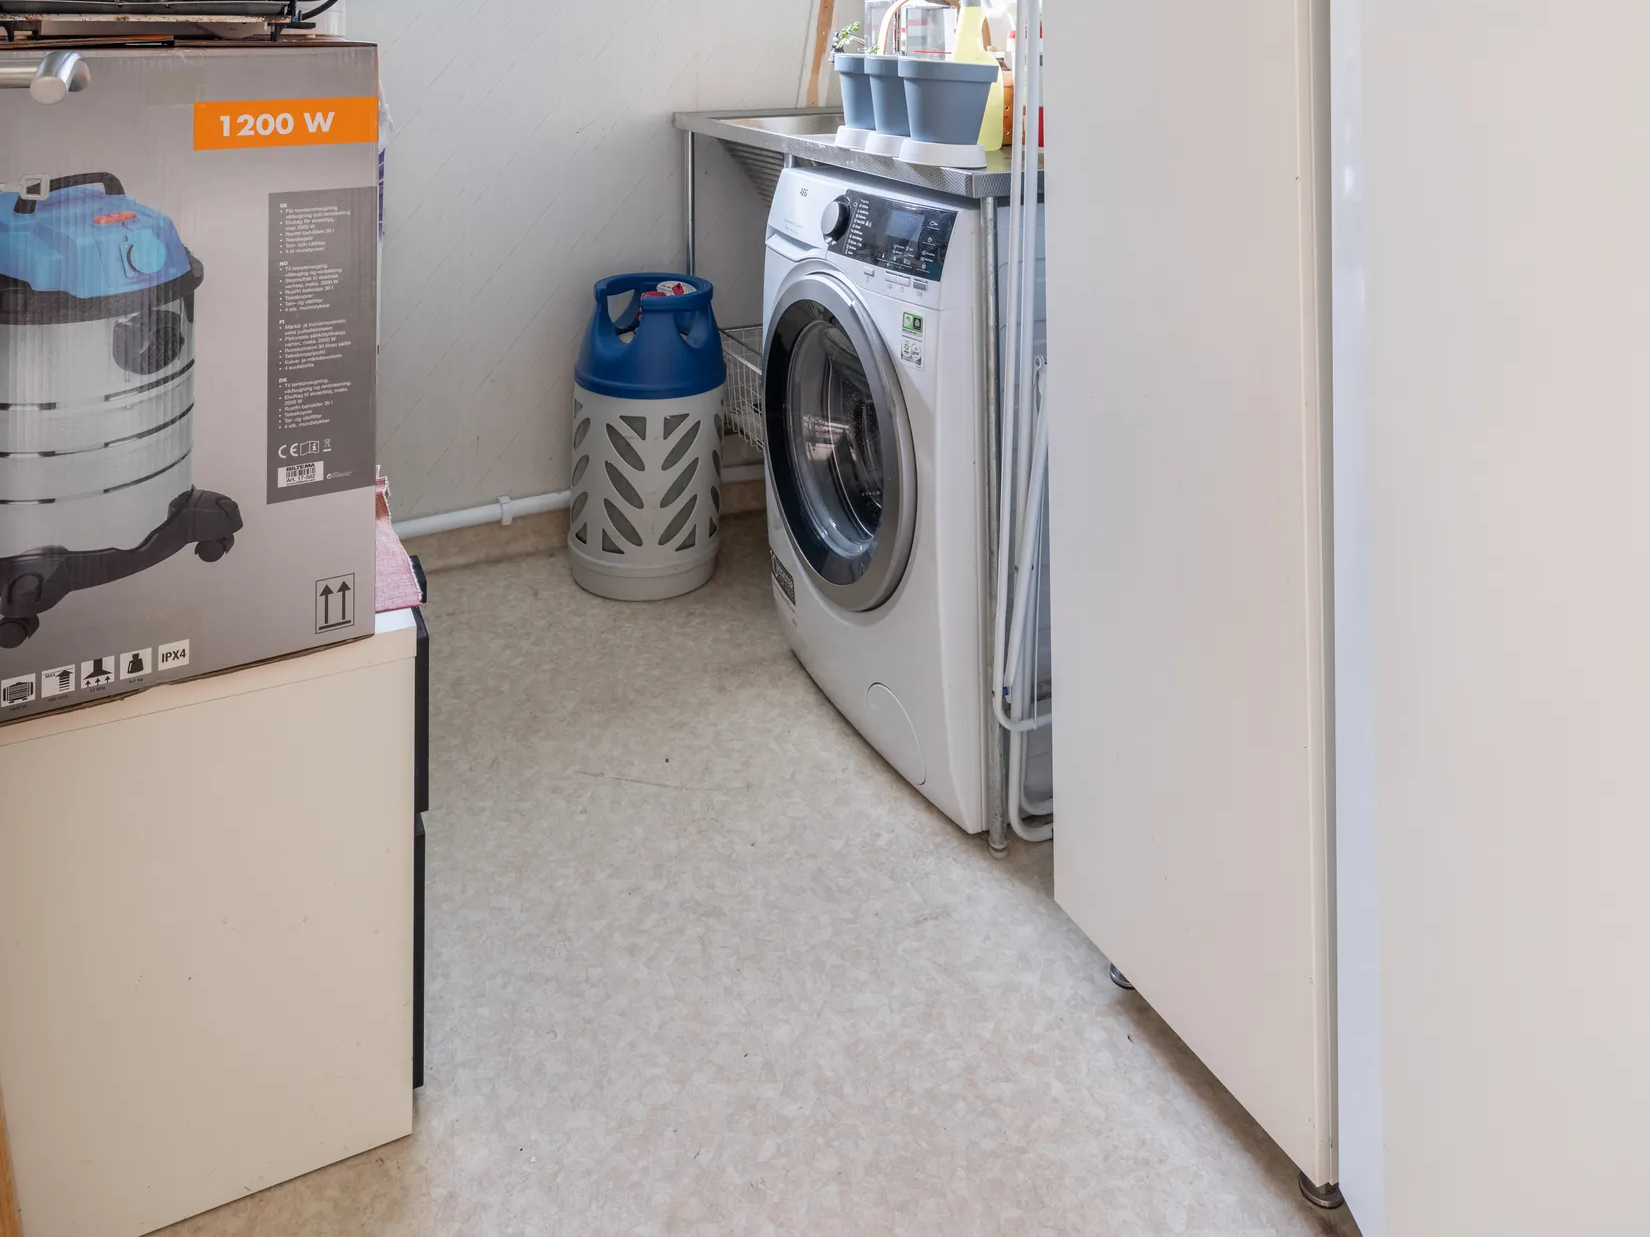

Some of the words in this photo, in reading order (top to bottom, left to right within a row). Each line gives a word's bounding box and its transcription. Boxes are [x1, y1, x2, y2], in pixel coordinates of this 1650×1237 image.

[220, 113, 294, 137] 1200
[303, 112, 335, 133] W
[800, 188, 808, 197] AEG
[287, 463, 315, 471] BILTEMA
[161, 648, 187, 663] IPX4
